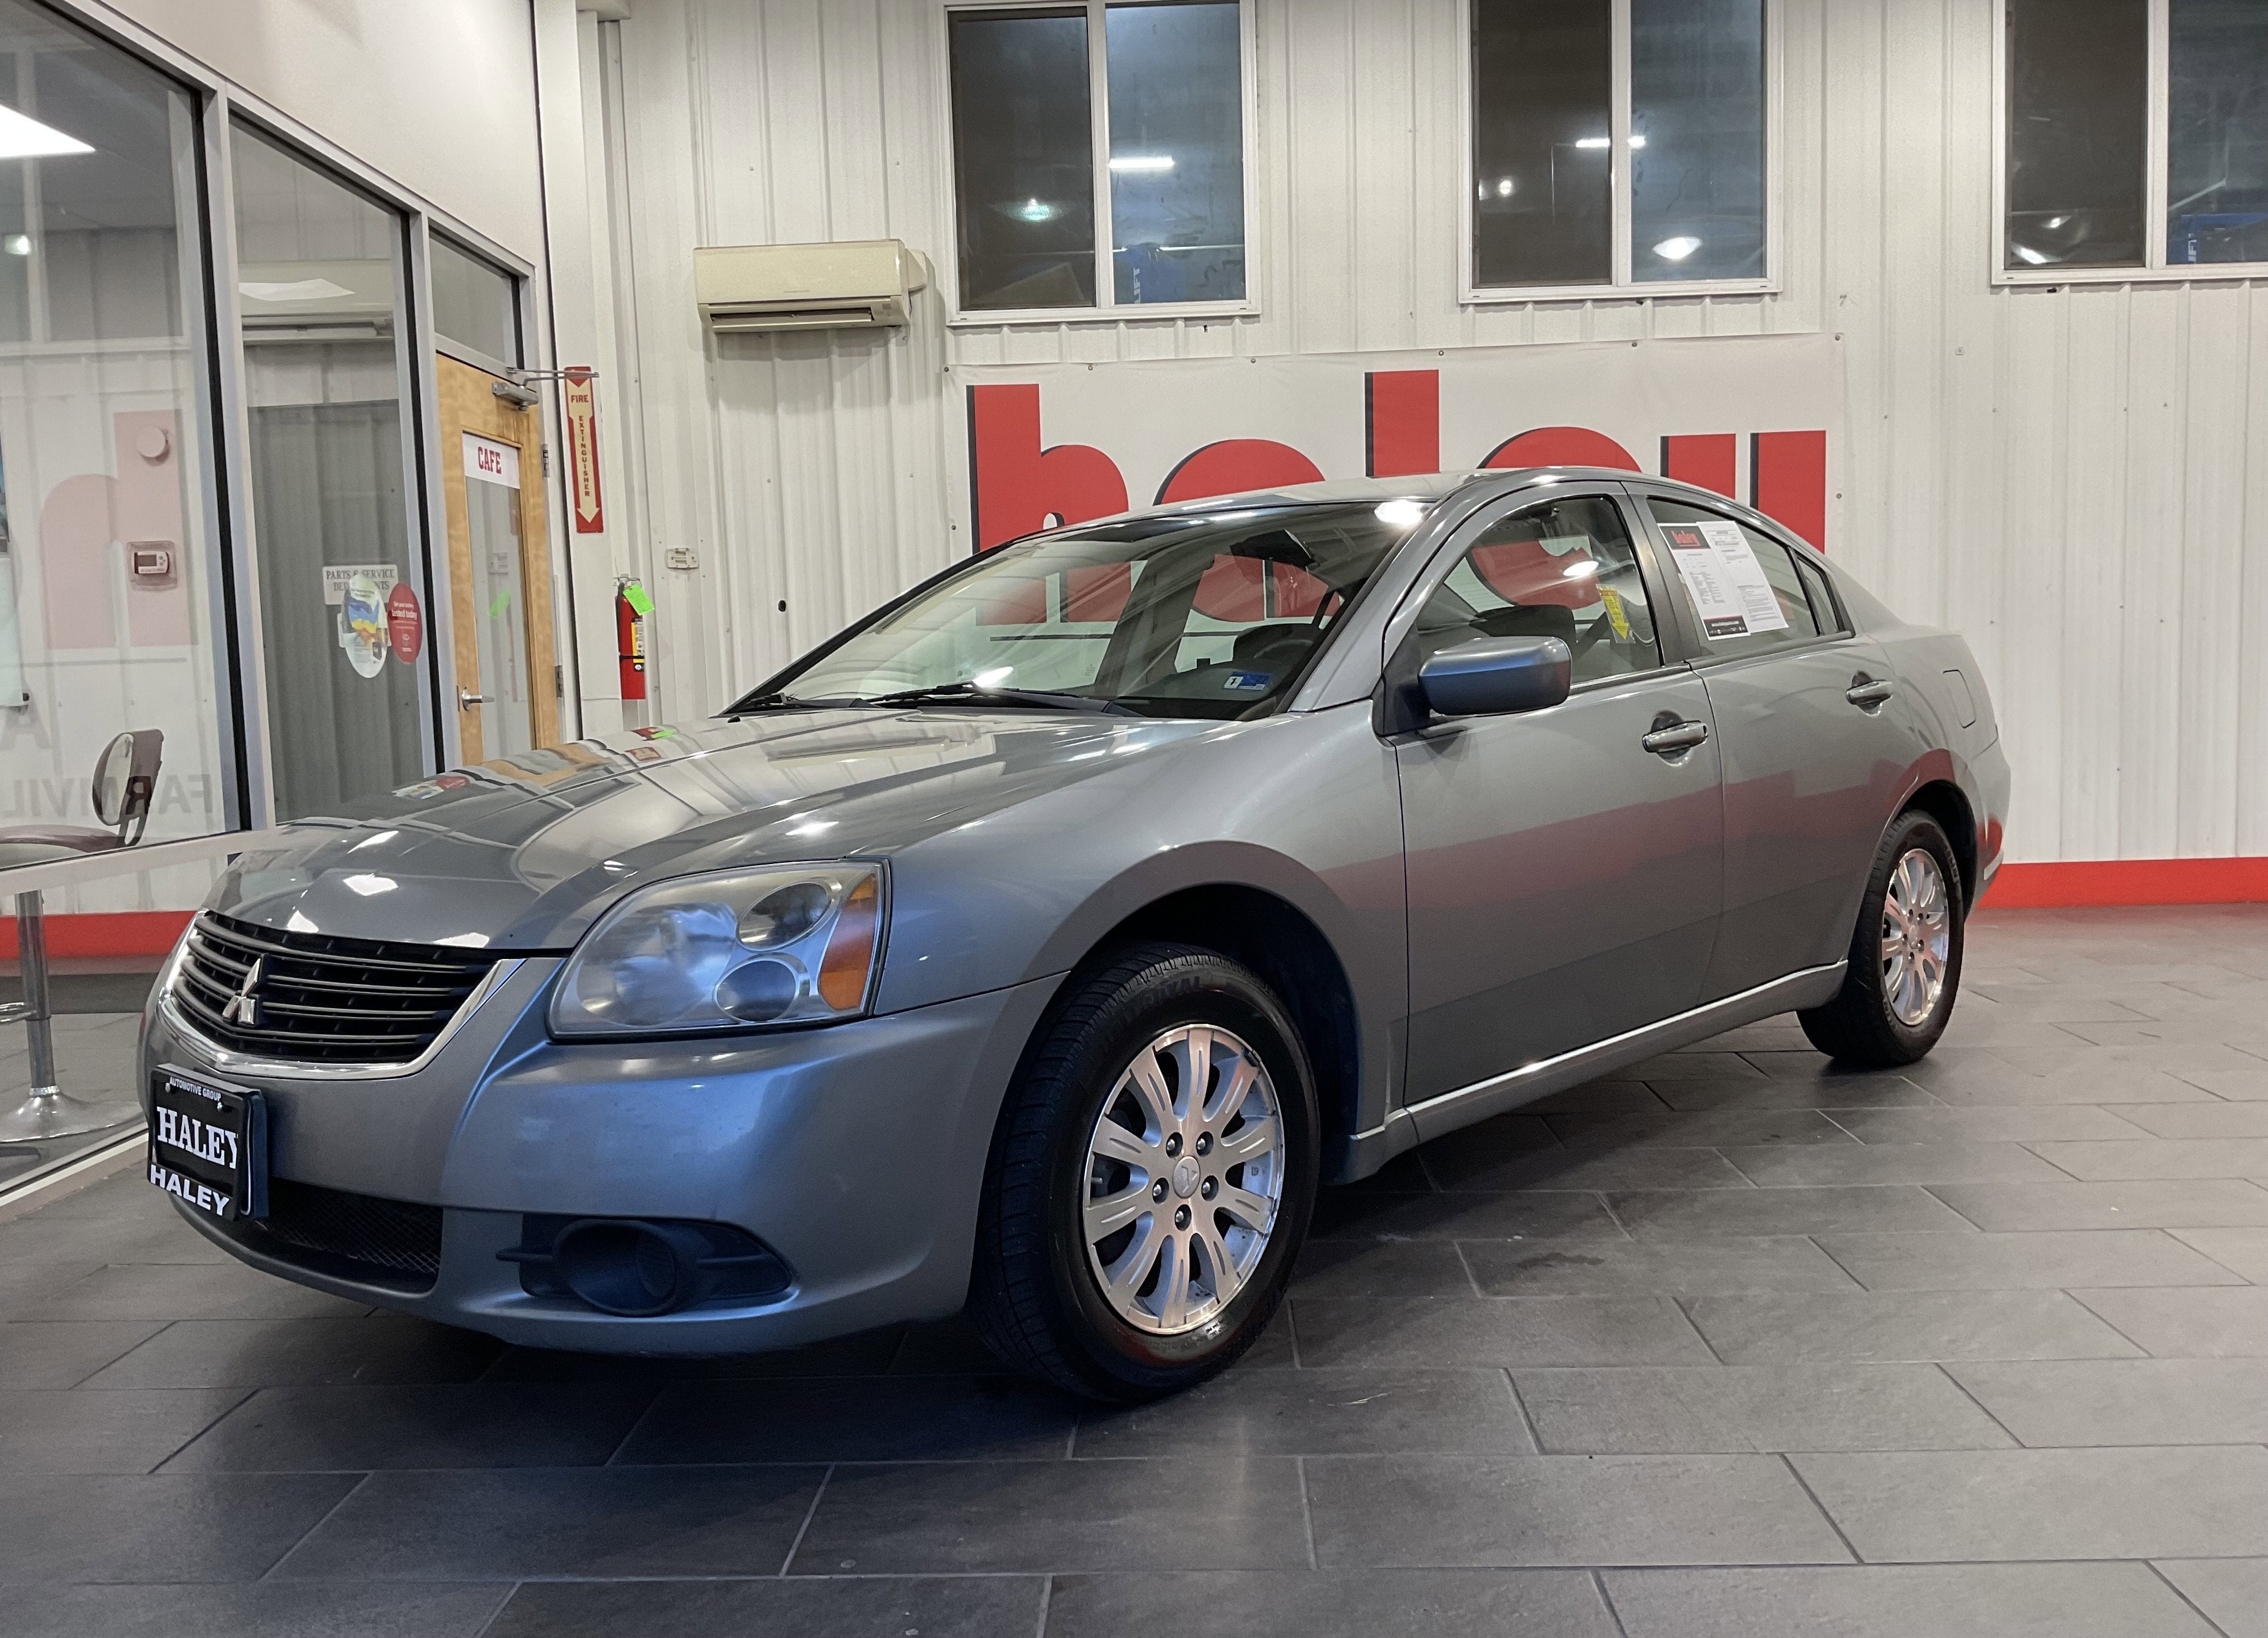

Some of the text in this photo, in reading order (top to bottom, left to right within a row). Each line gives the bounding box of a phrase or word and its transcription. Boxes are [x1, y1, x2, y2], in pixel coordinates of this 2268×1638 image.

[571, 394, 589, 403] FIRE
[478, 446, 502, 474] CAFE
[578, 415, 590, 497] EXTINGUISHER
[325, 570, 351, 579] PARTS
[361, 569, 395, 578] SERVICE
[333, 580, 390, 591] DEPNTS
[170, 1076, 222, 1101] AUTOMOTIVE GROUP
[156, 1106, 238, 1169] HALEY
[150, 1164, 230, 1216] HALEY
